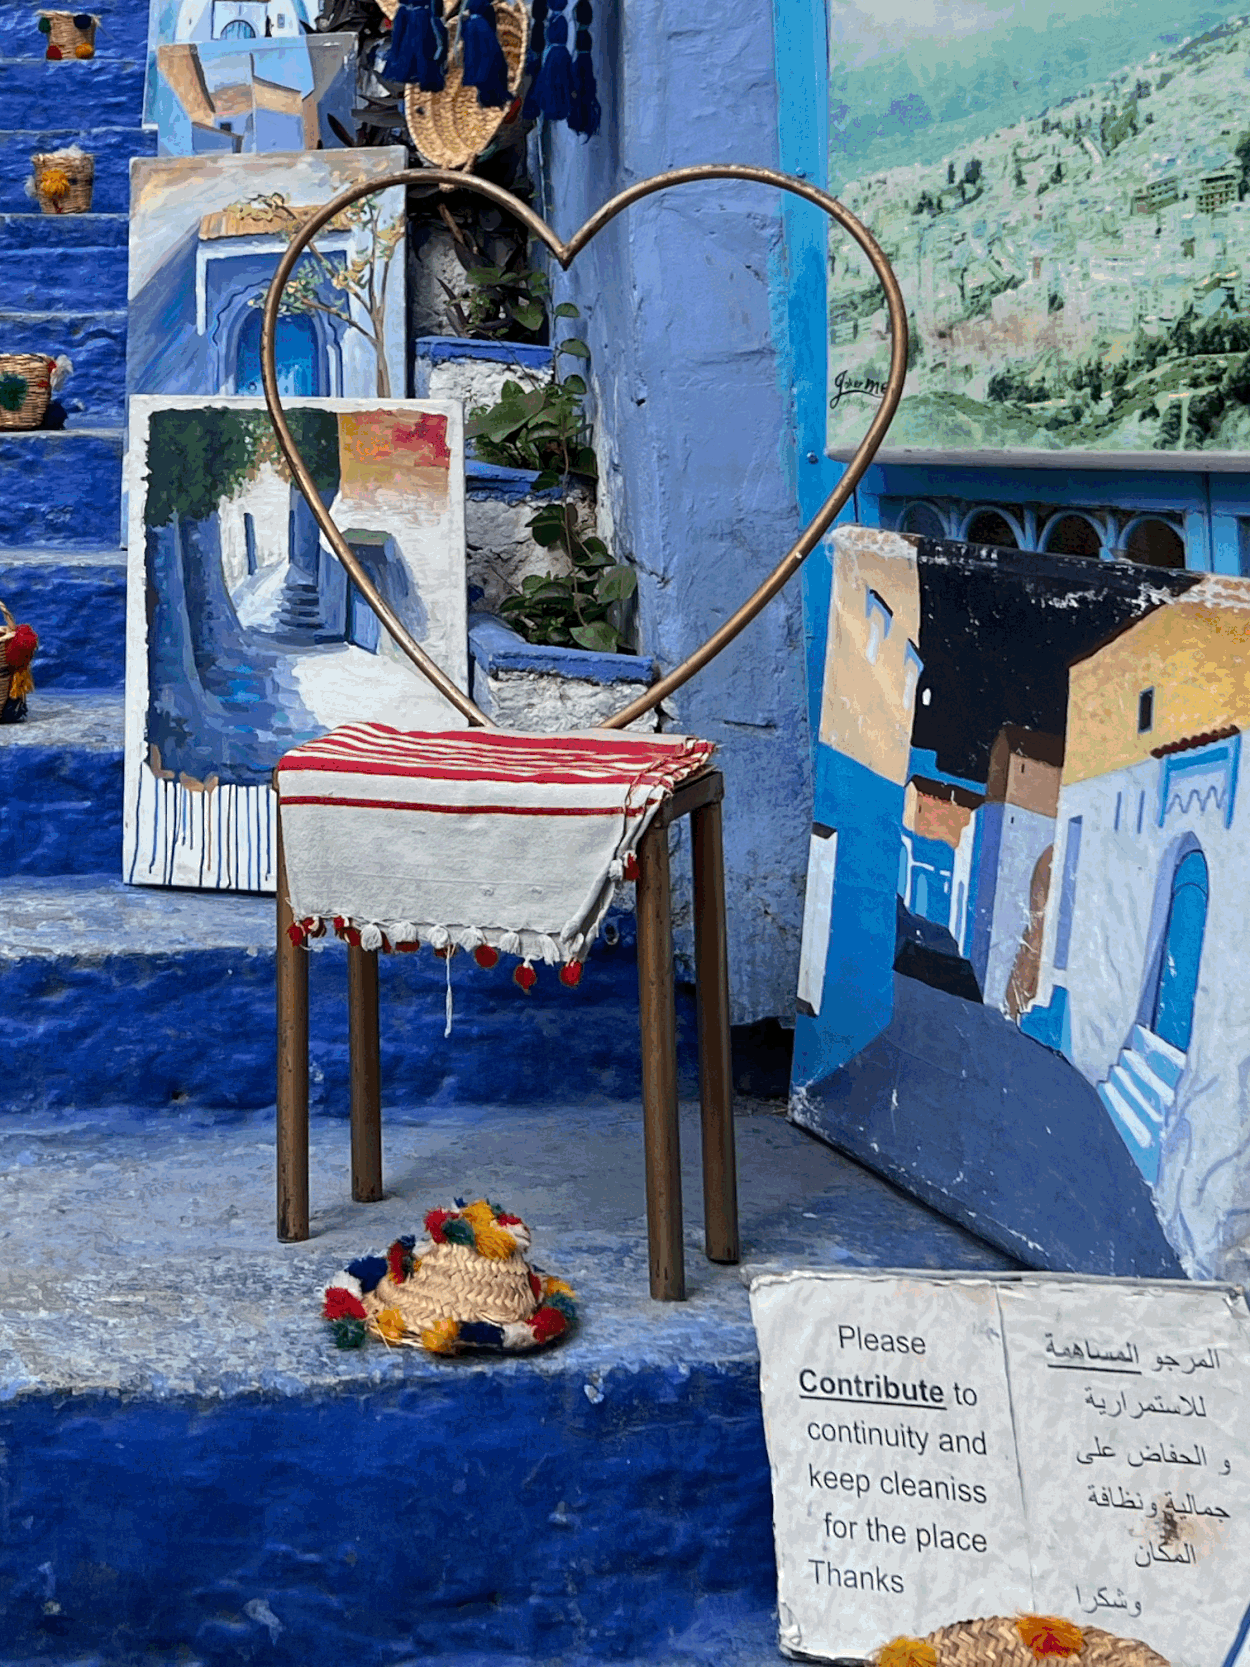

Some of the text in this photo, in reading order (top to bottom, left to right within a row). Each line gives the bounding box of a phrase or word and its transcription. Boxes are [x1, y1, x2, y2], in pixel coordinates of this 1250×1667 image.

[838, 1325, 926, 1355] Please
[1045, 1333, 1220, 1374] المرجو المساهمة
[799, 1369, 978, 1406] Contribute to
[1085, 1387, 1206, 1419] للاستمرارية
[808, 1420, 987, 1455] continuity and
[1077, 1436, 1116, 1464] على
[1127, 1443, 1207, 1467] الحفاض
[809, 1463, 987, 1503] keep cleaniss
[1164, 1491, 1231, 1523] جمالية
[824, 1512, 987, 1553] for the place
[1135, 1540, 1196, 1567] المكان
[808, 1559, 904, 1594] Thanks
[1076, 1585, 1142, 1617] وشكرا
